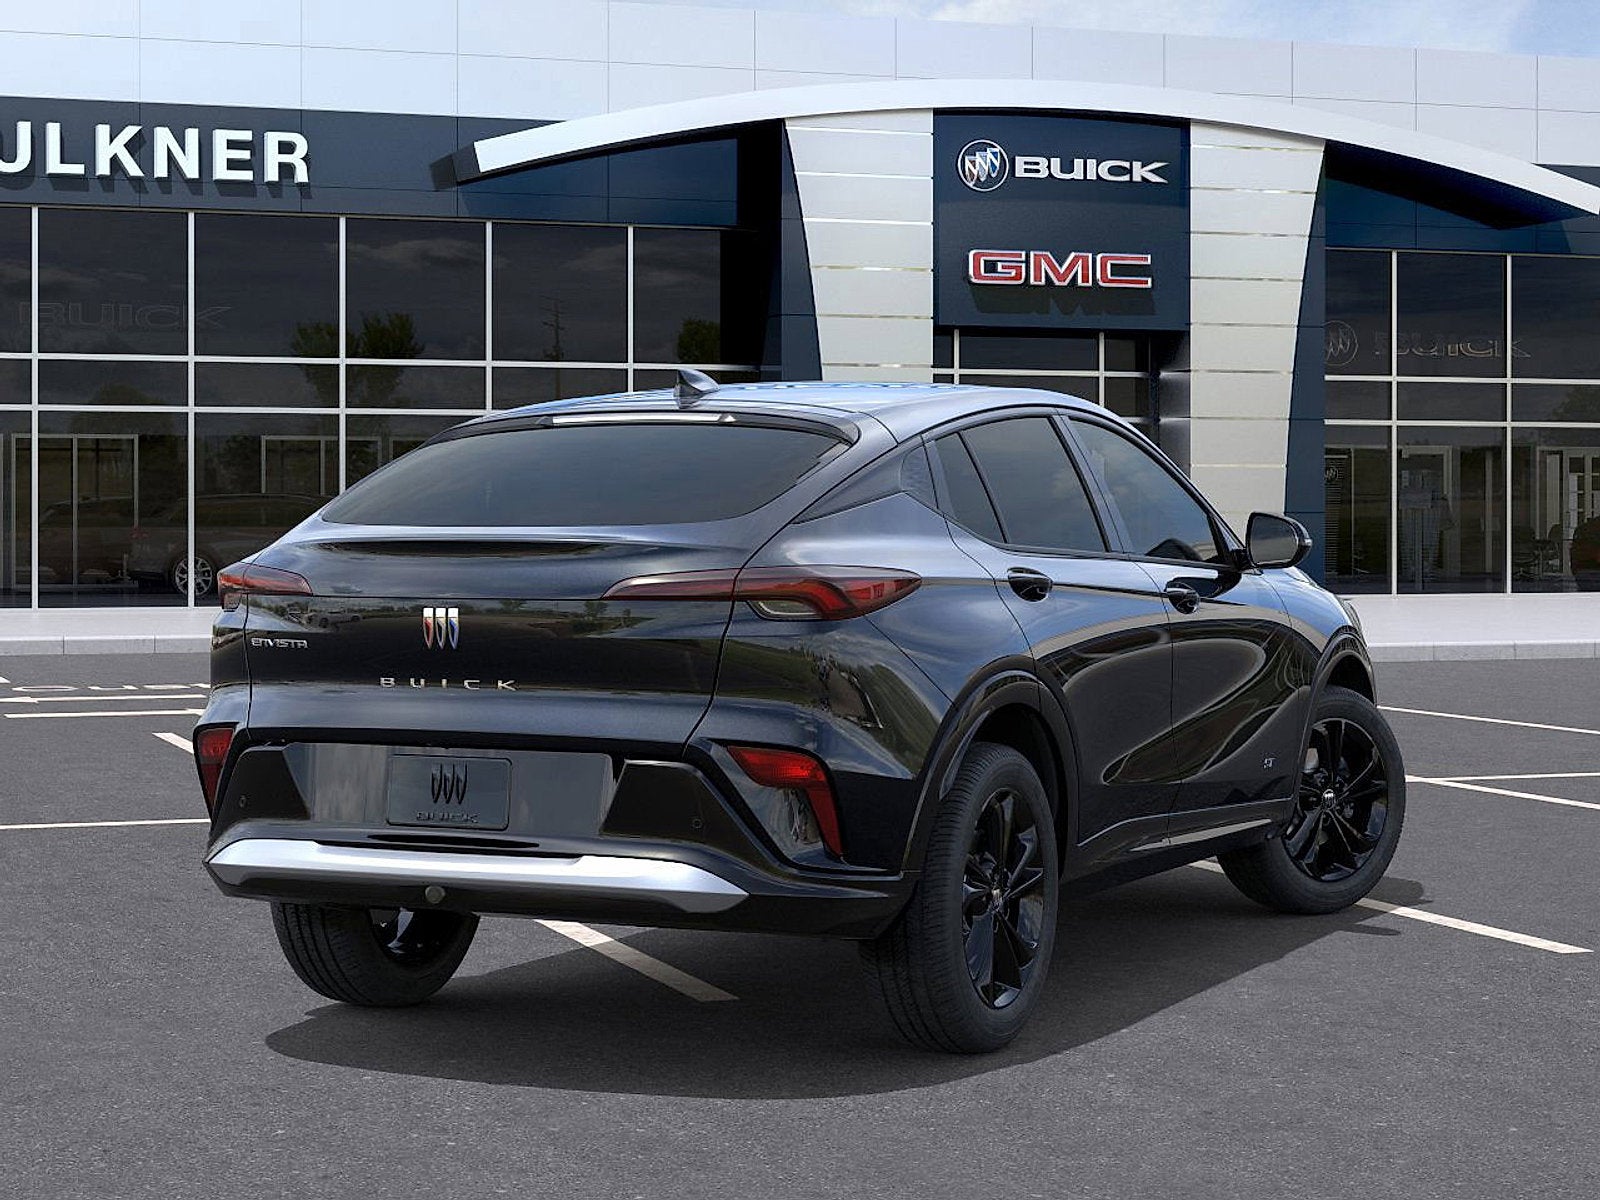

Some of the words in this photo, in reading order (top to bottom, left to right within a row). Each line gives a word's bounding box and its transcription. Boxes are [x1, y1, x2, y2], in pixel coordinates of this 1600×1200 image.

[1015, 155, 1169, 184] BUICK
[968, 249, 1152, 289] GMC
[379, 676, 518, 691] BUICK
